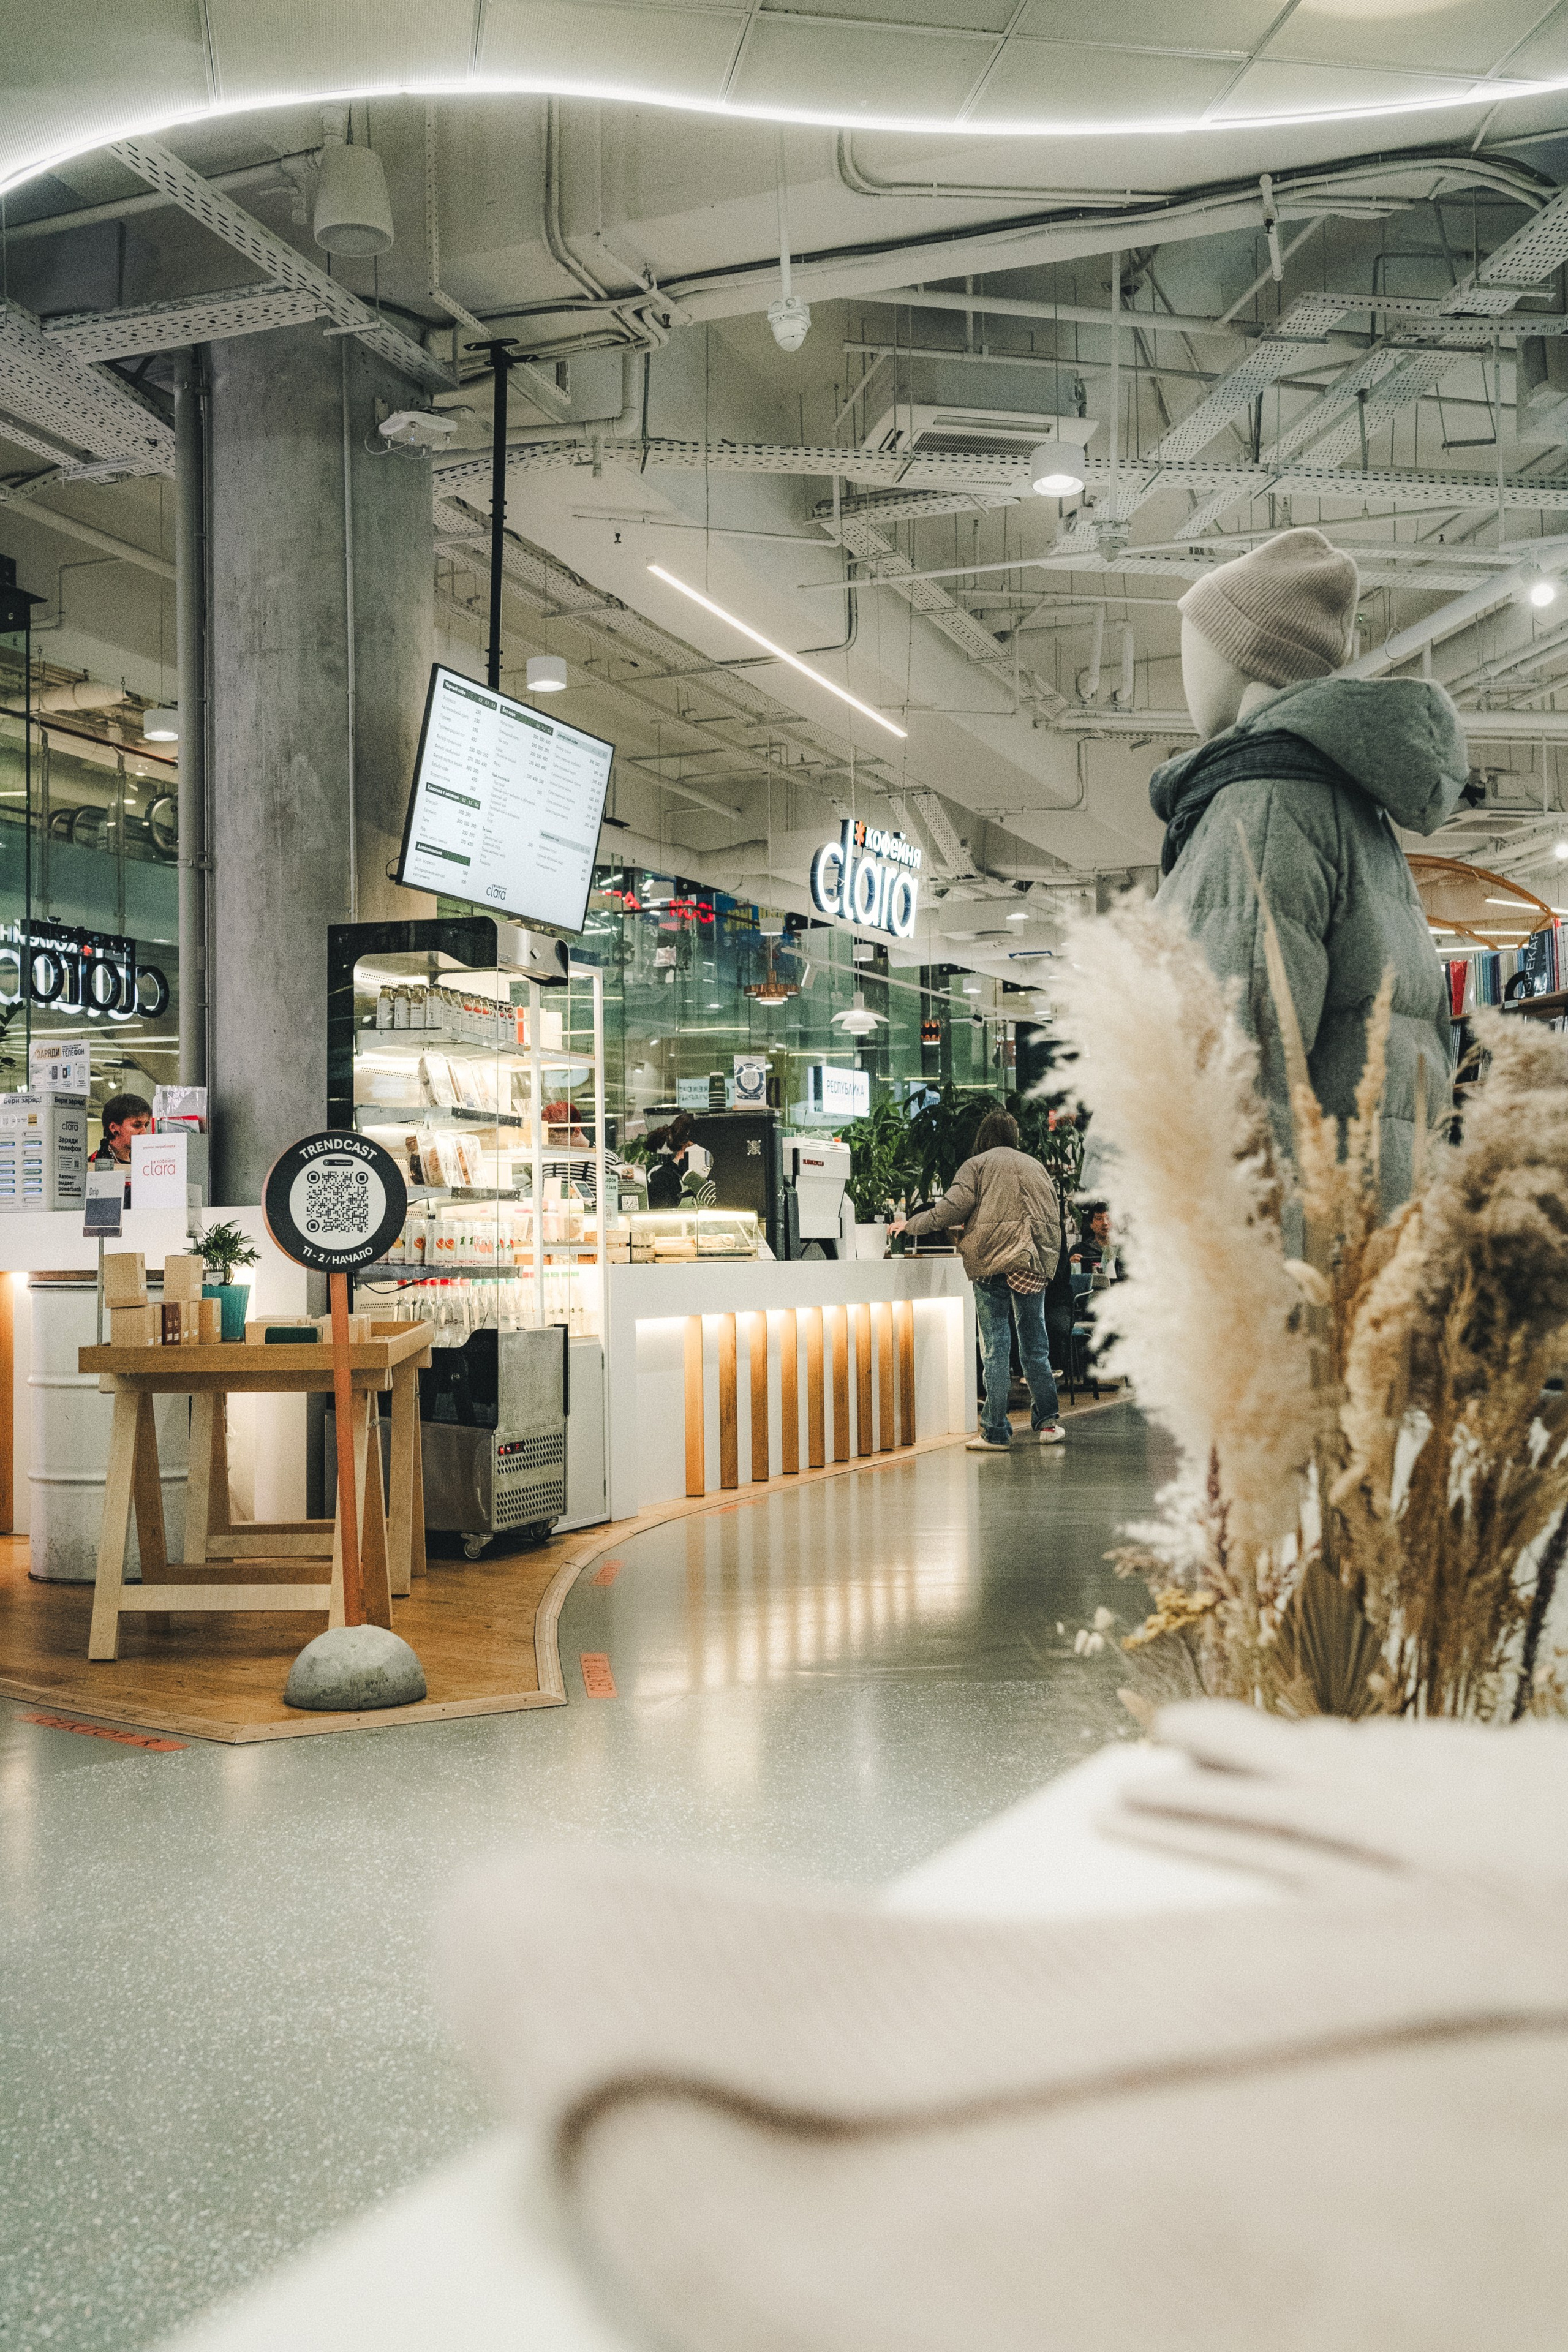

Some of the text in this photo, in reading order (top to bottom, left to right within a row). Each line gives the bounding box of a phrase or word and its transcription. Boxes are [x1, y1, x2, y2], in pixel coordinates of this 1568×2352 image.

[865, 832, 921, 869] кофейня
[811, 819, 919, 938] clara
[486, 884, 506, 900] clara
[37, 1048, 60, 1059] ЗАРЯДИ
[62, 1049, 85, 1057] ТЕЛЕФОН
[827, 1080, 864, 1096] РЕСПУБЛИКА
[62, 1121, 78, 1131] clara
[299, 1139, 377, 1159] TRENDCAST
[143, 1160, 176, 1176] clara
[89, 1187, 99, 1197] Drip
[332, 1246, 373, 1264] НАЧАЛО
[36, 1717, 135, 1740] СЕКТОР
